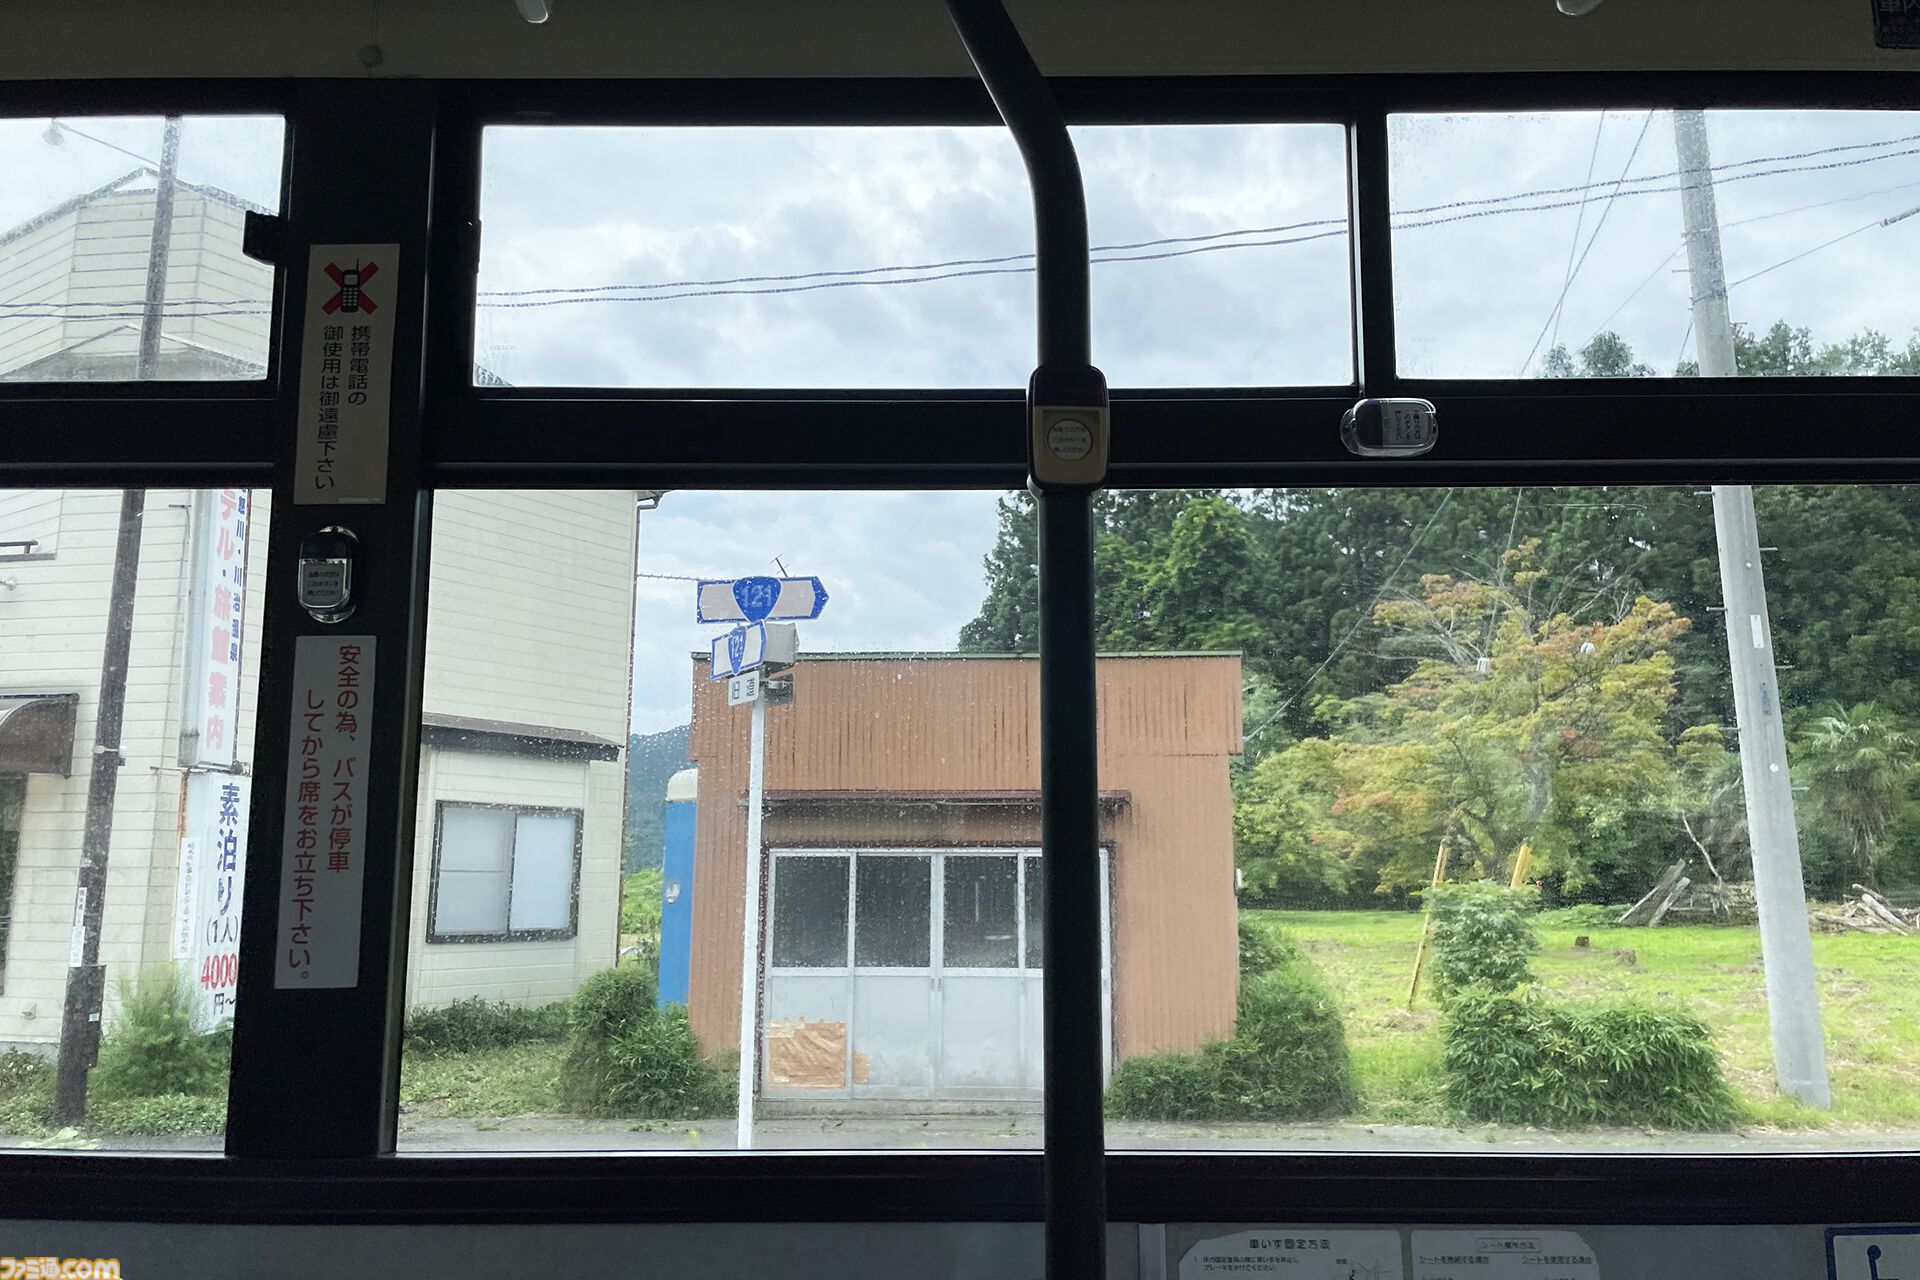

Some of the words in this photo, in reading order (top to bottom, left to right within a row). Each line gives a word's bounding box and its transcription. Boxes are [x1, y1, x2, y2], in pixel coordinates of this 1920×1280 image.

[348, 325, 371, 406] 携帯電話の
[315, 326, 344, 490] 御使用は御遠慮下さい
[741, 584, 773, 608] 121
[730, 634, 744, 658] 121
[327, 644, 361, 873] 安全の為、バスが停車
[217, 782, 240, 917] 素泊り
[288, 689, 325, 979] してから席をお立ち下さい。
[206, 915, 239, 946] (1人)
[200, 953, 237, 991] 4000
[1249, 1238, 1331, 1249] 車いす固定方法
